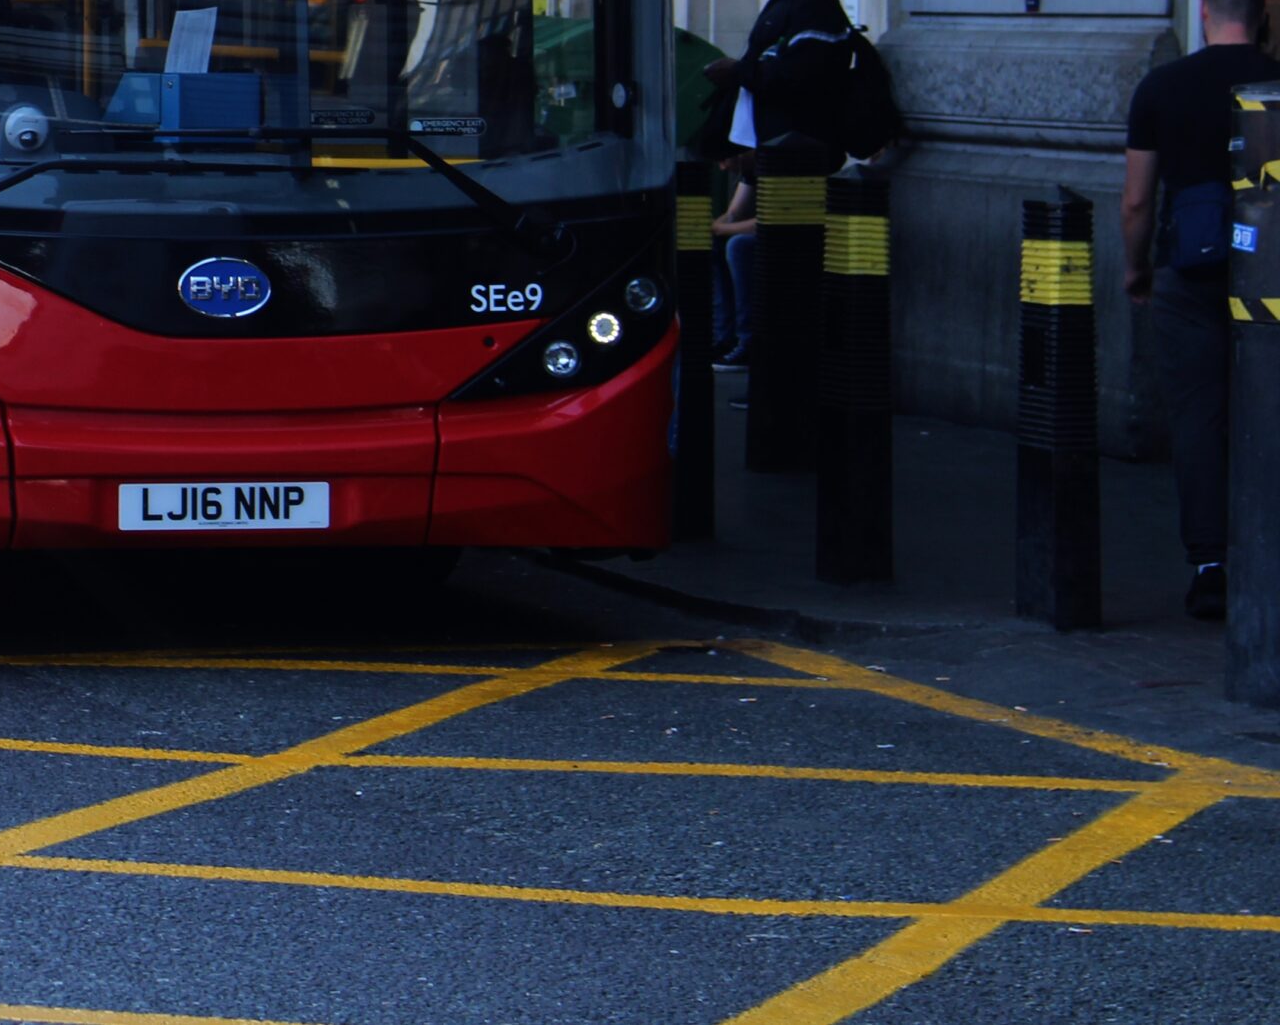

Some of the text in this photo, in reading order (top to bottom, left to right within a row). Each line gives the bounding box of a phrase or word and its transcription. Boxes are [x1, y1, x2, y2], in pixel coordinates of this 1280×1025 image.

[189, 276, 260, 299] BYD
[470, 283, 543, 312] SEe9
[142, 486, 304, 521] LJ16 NNP
